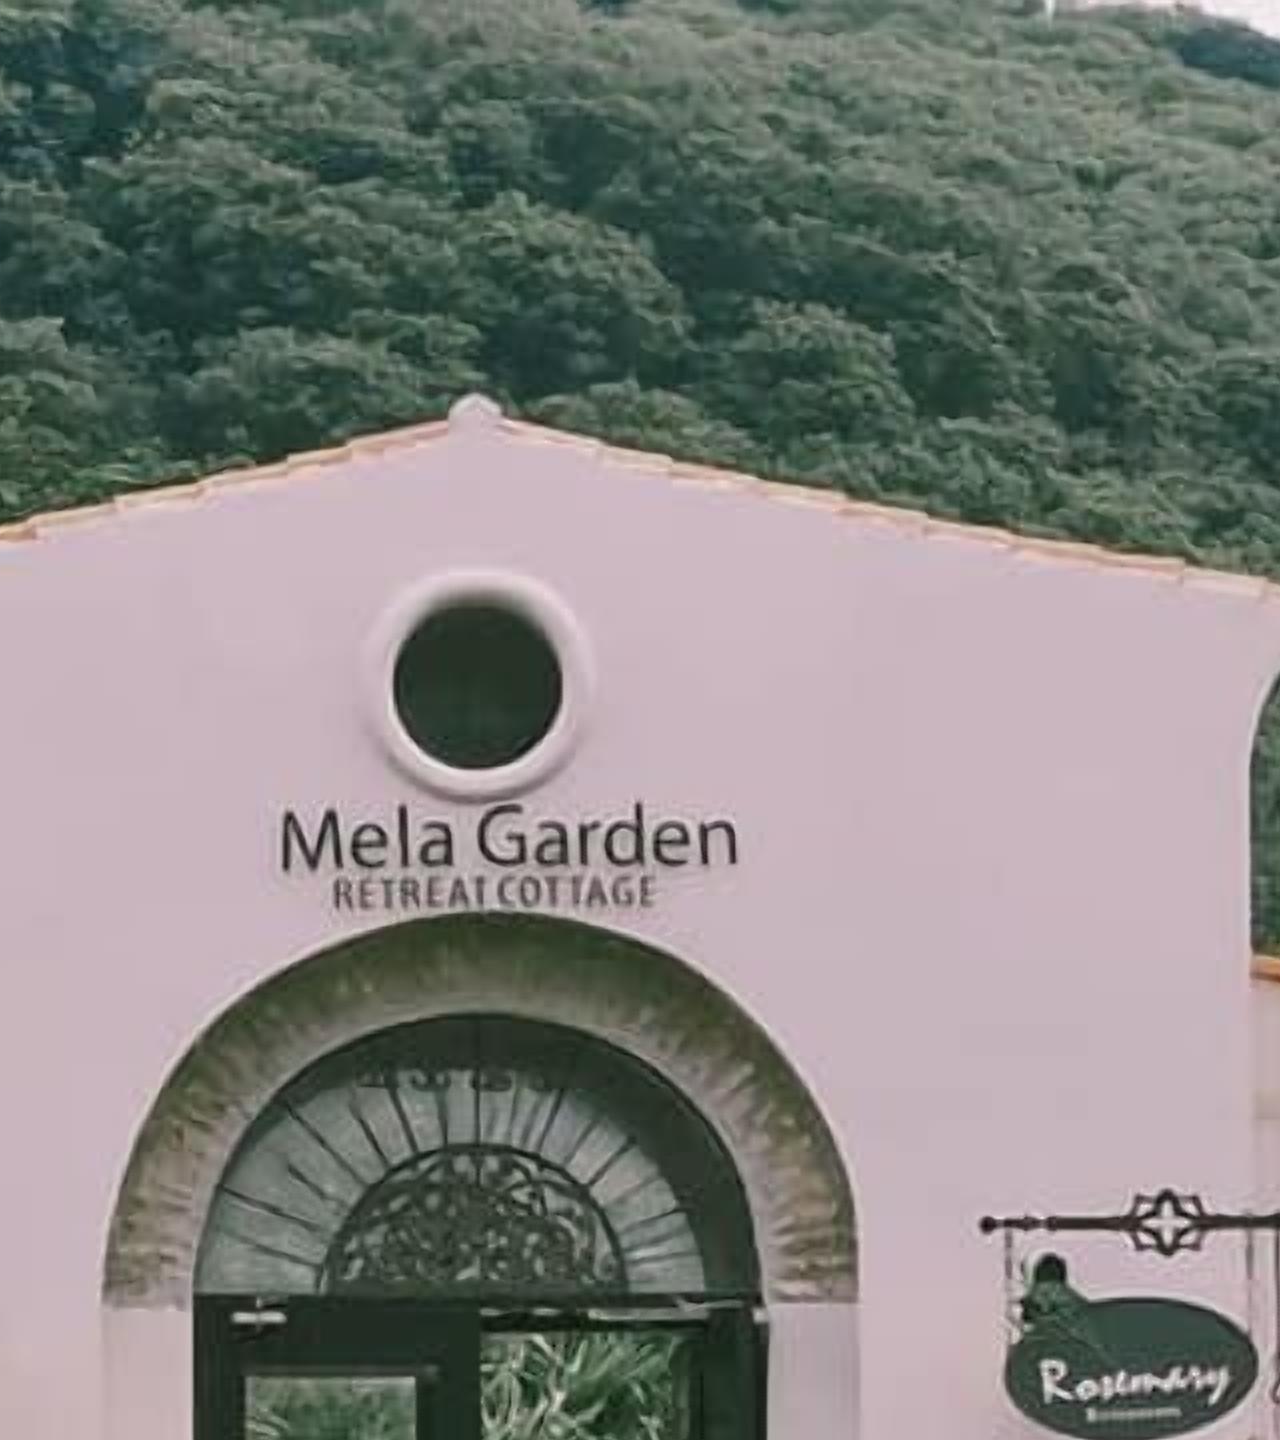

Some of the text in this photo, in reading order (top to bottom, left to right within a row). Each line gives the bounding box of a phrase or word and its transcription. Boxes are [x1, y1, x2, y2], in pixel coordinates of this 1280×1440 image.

[281, 802, 739, 871] Mela Garden
[332, 874, 657, 910] RETREAT COTTAGE
[1038, 1358, 1229, 1405] Rosemary
